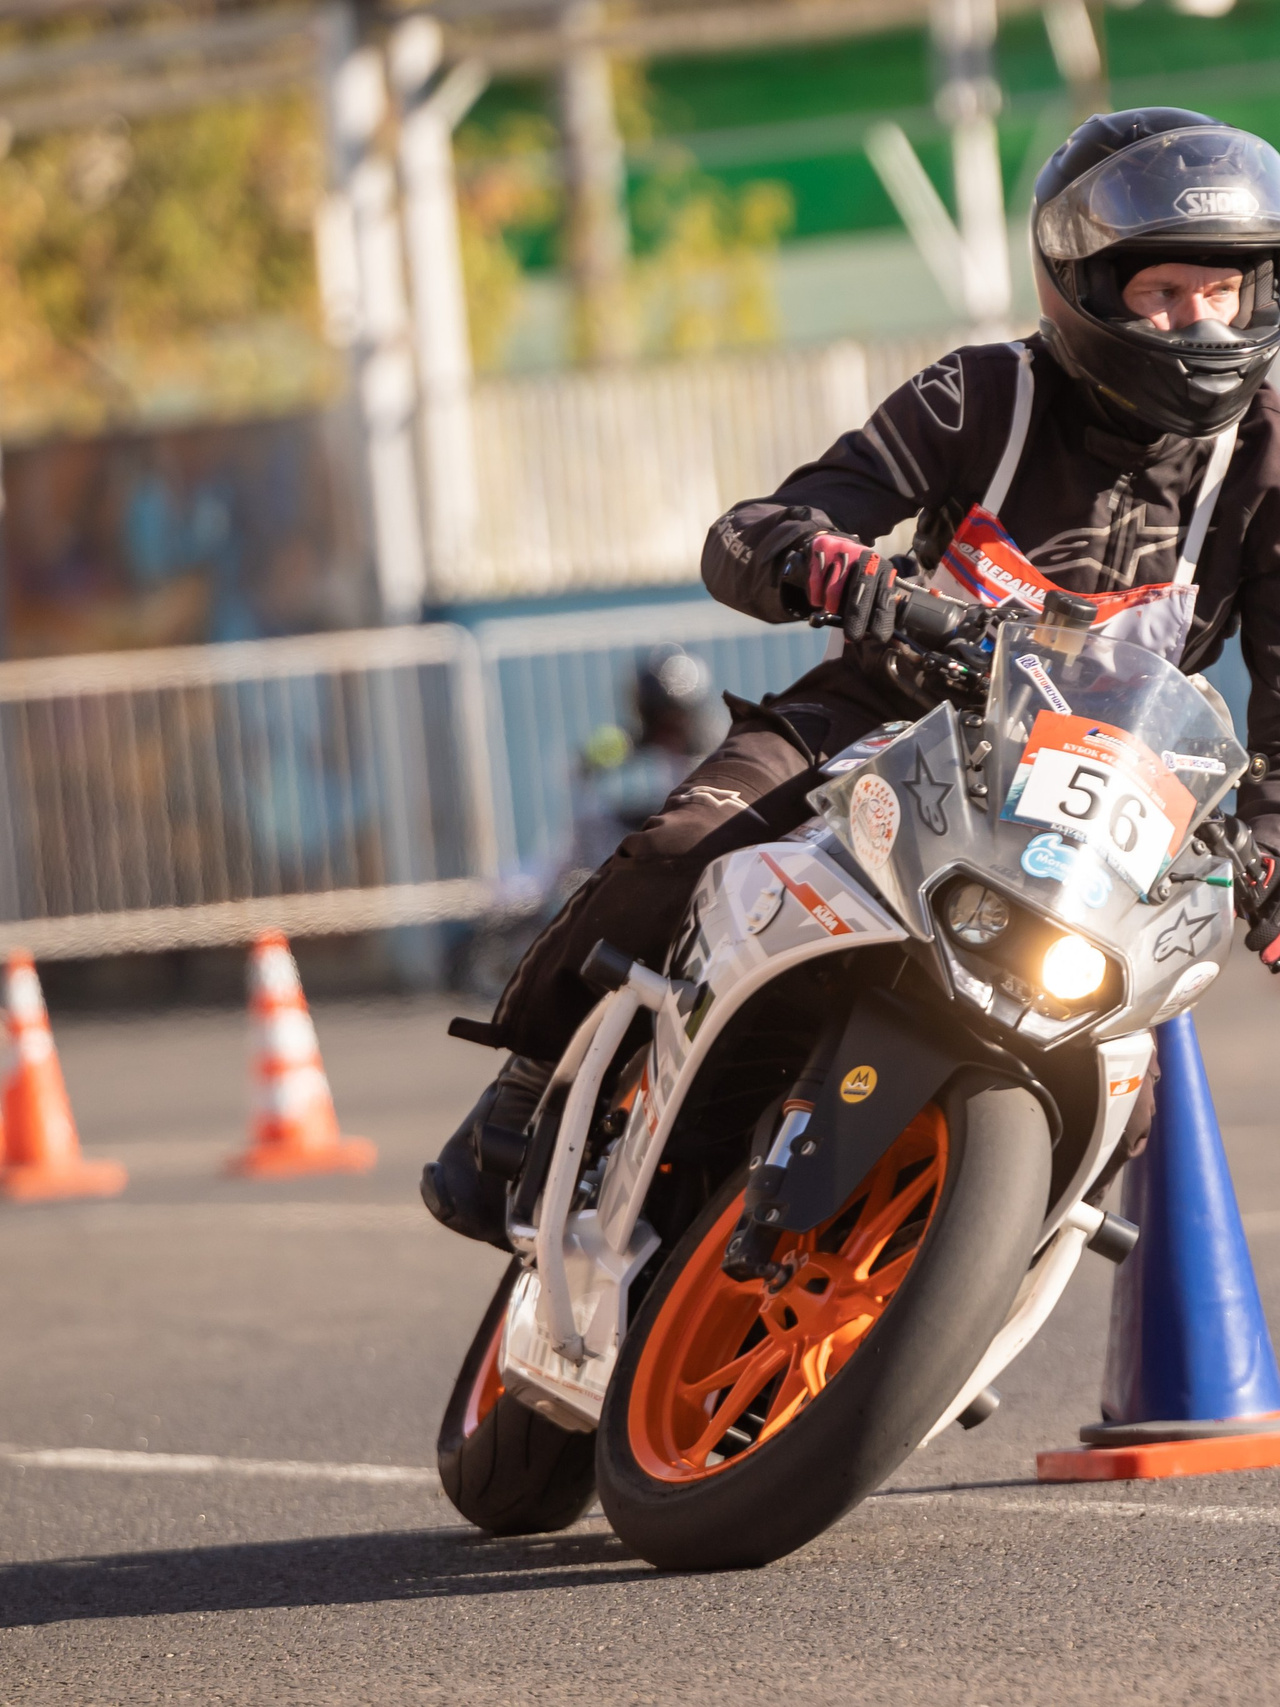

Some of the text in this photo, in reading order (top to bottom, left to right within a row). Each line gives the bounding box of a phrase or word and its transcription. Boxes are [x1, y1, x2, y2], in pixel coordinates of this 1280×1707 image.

[1186, 192, 1251, 214] SHO
[1059, 765, 1147, 853] 56
[811, 904, 839, 931] KTM
